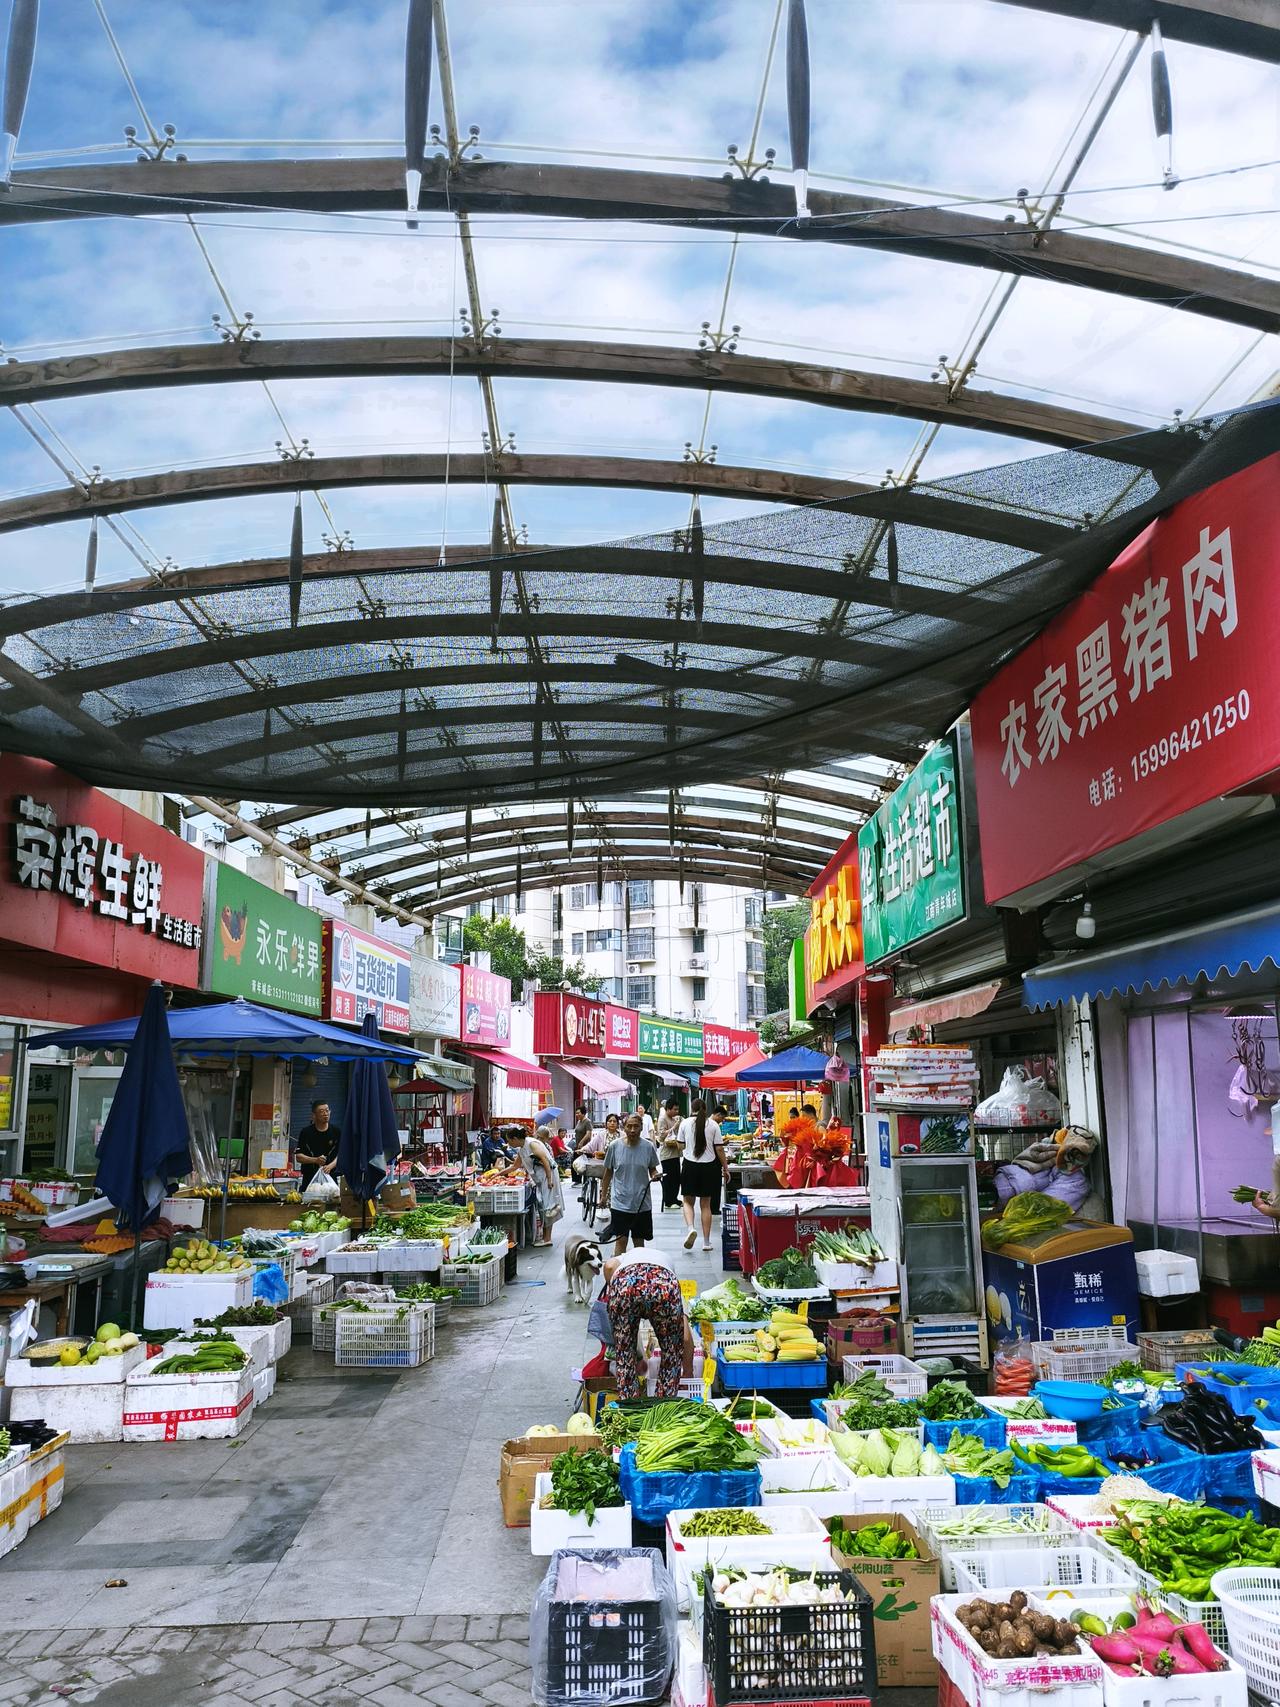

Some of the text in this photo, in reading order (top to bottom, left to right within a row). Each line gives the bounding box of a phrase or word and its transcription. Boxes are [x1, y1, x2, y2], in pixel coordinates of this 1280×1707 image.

[1000, 526, 1239, 788] 农家黑猪肉
[1130, 688, 1251, 783] 15996421250
[16, 795, 163, 933] 荣辉生鲜
[925, 888, 957, 921] 江南青年城店
[163, 915, 203, 949] 生活超市
[256, 918, 319, 983] 永乐鲜果
[355, 951, 396, 1001] 百货超市
[1074, 1272, 1102, 1288] 甄稀
[852, 1563, 894, 1575] 长阳山蔬
